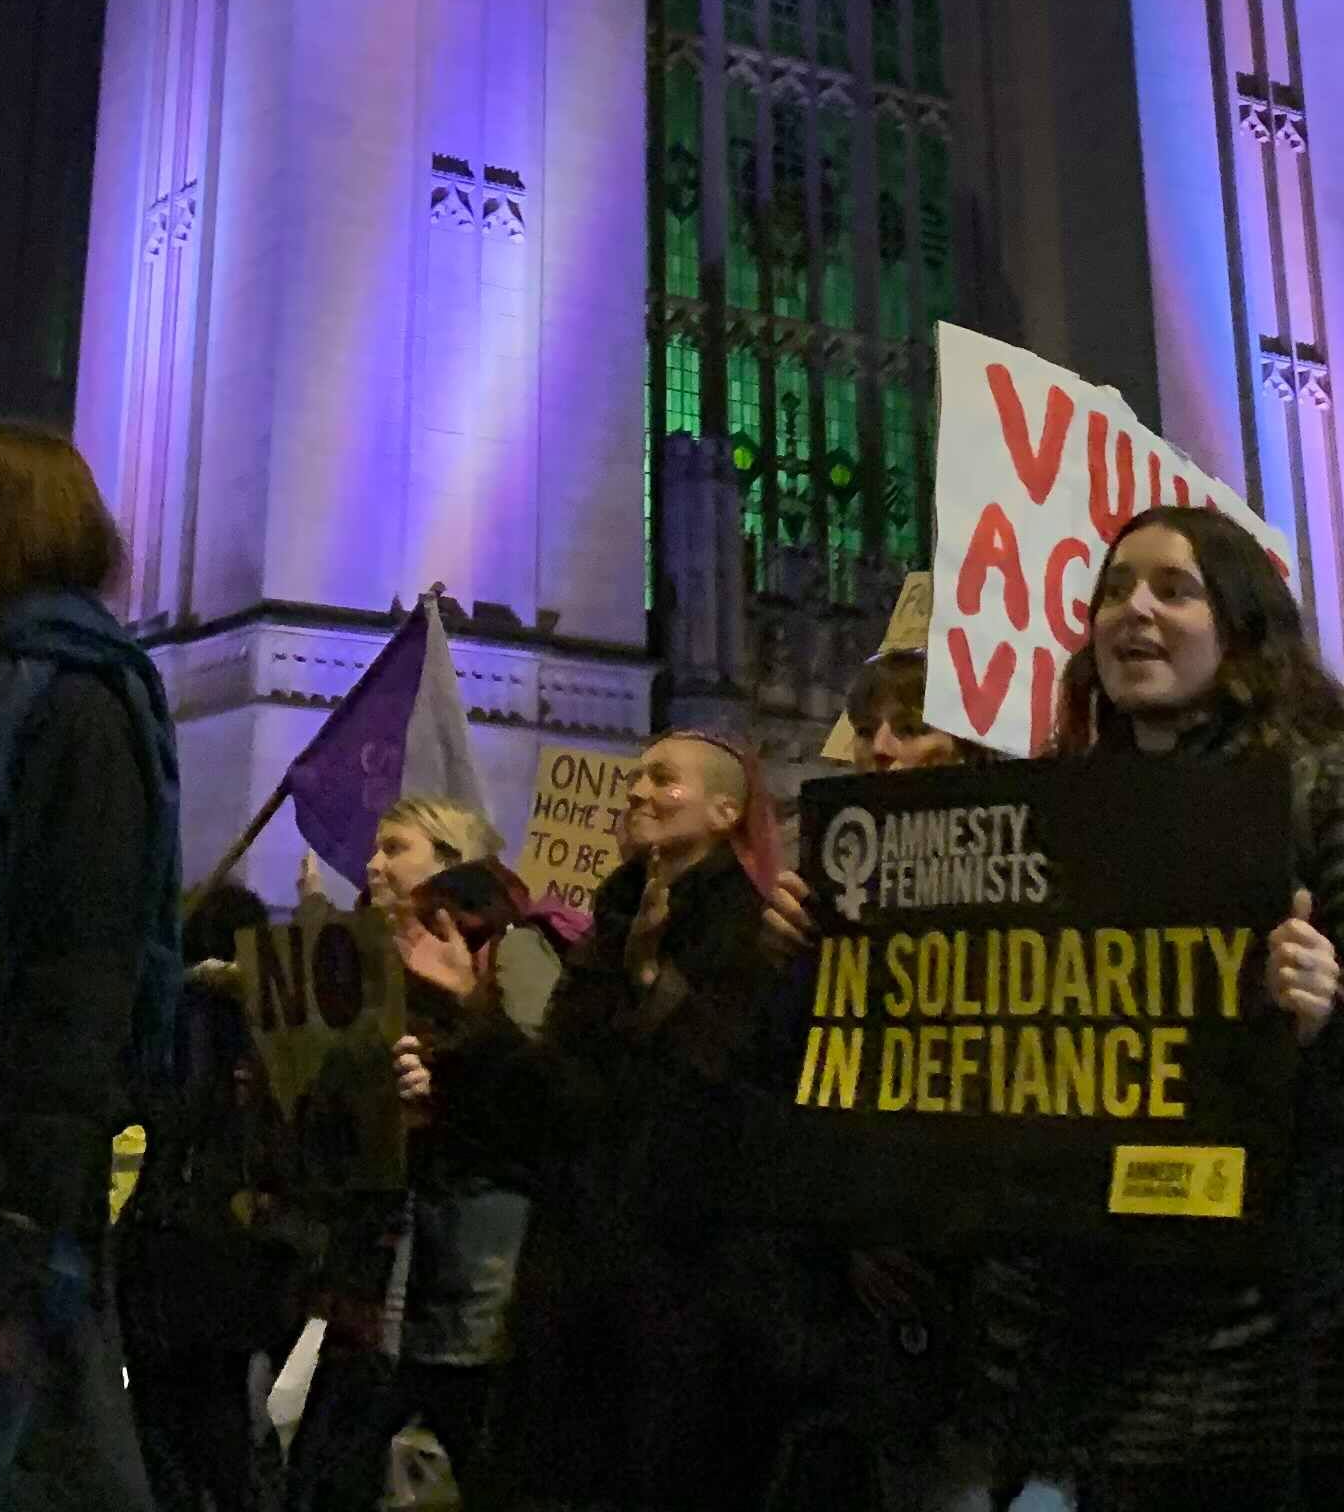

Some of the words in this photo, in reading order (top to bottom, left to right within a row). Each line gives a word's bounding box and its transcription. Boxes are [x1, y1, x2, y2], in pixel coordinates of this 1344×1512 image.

[551, 754, 605, 798] ON
[533, 791, 599, 829] HOME
[880, 804, 1030, 859] AMNESTY
[530, 831, 569, 867] TO
[574, 844, 610, 880] BE
[879, 852, 1048, 908] FEMINISTS
[256, 924, 362, 1029] NO
[812, 935, 869, 1019] IN
[884, 928, 1251, 1019] SOLIDARITY
[794, 1026, 864, 1109] IN
[877, 1026, 1190, 1119] DEFIANCE
